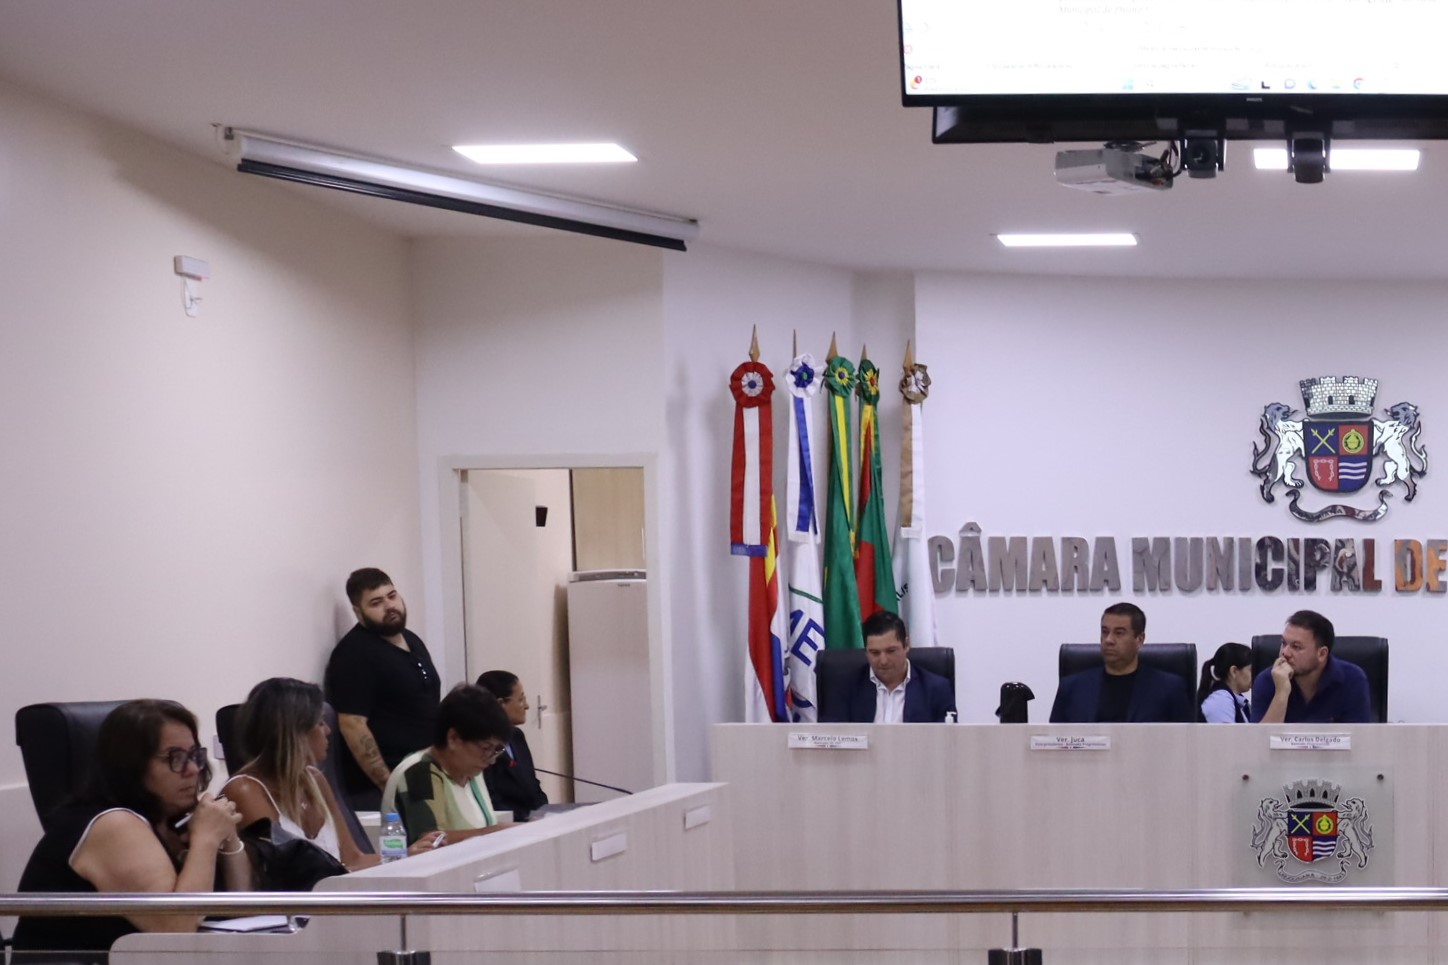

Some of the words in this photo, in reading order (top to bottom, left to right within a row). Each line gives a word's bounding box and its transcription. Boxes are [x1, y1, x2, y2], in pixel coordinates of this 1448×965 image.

[927, 521, 1121, 593] CÂMARA
[1131, 536, 1382, 593] MUNICIPAL
[1394, 538, 1447, 593] DE
